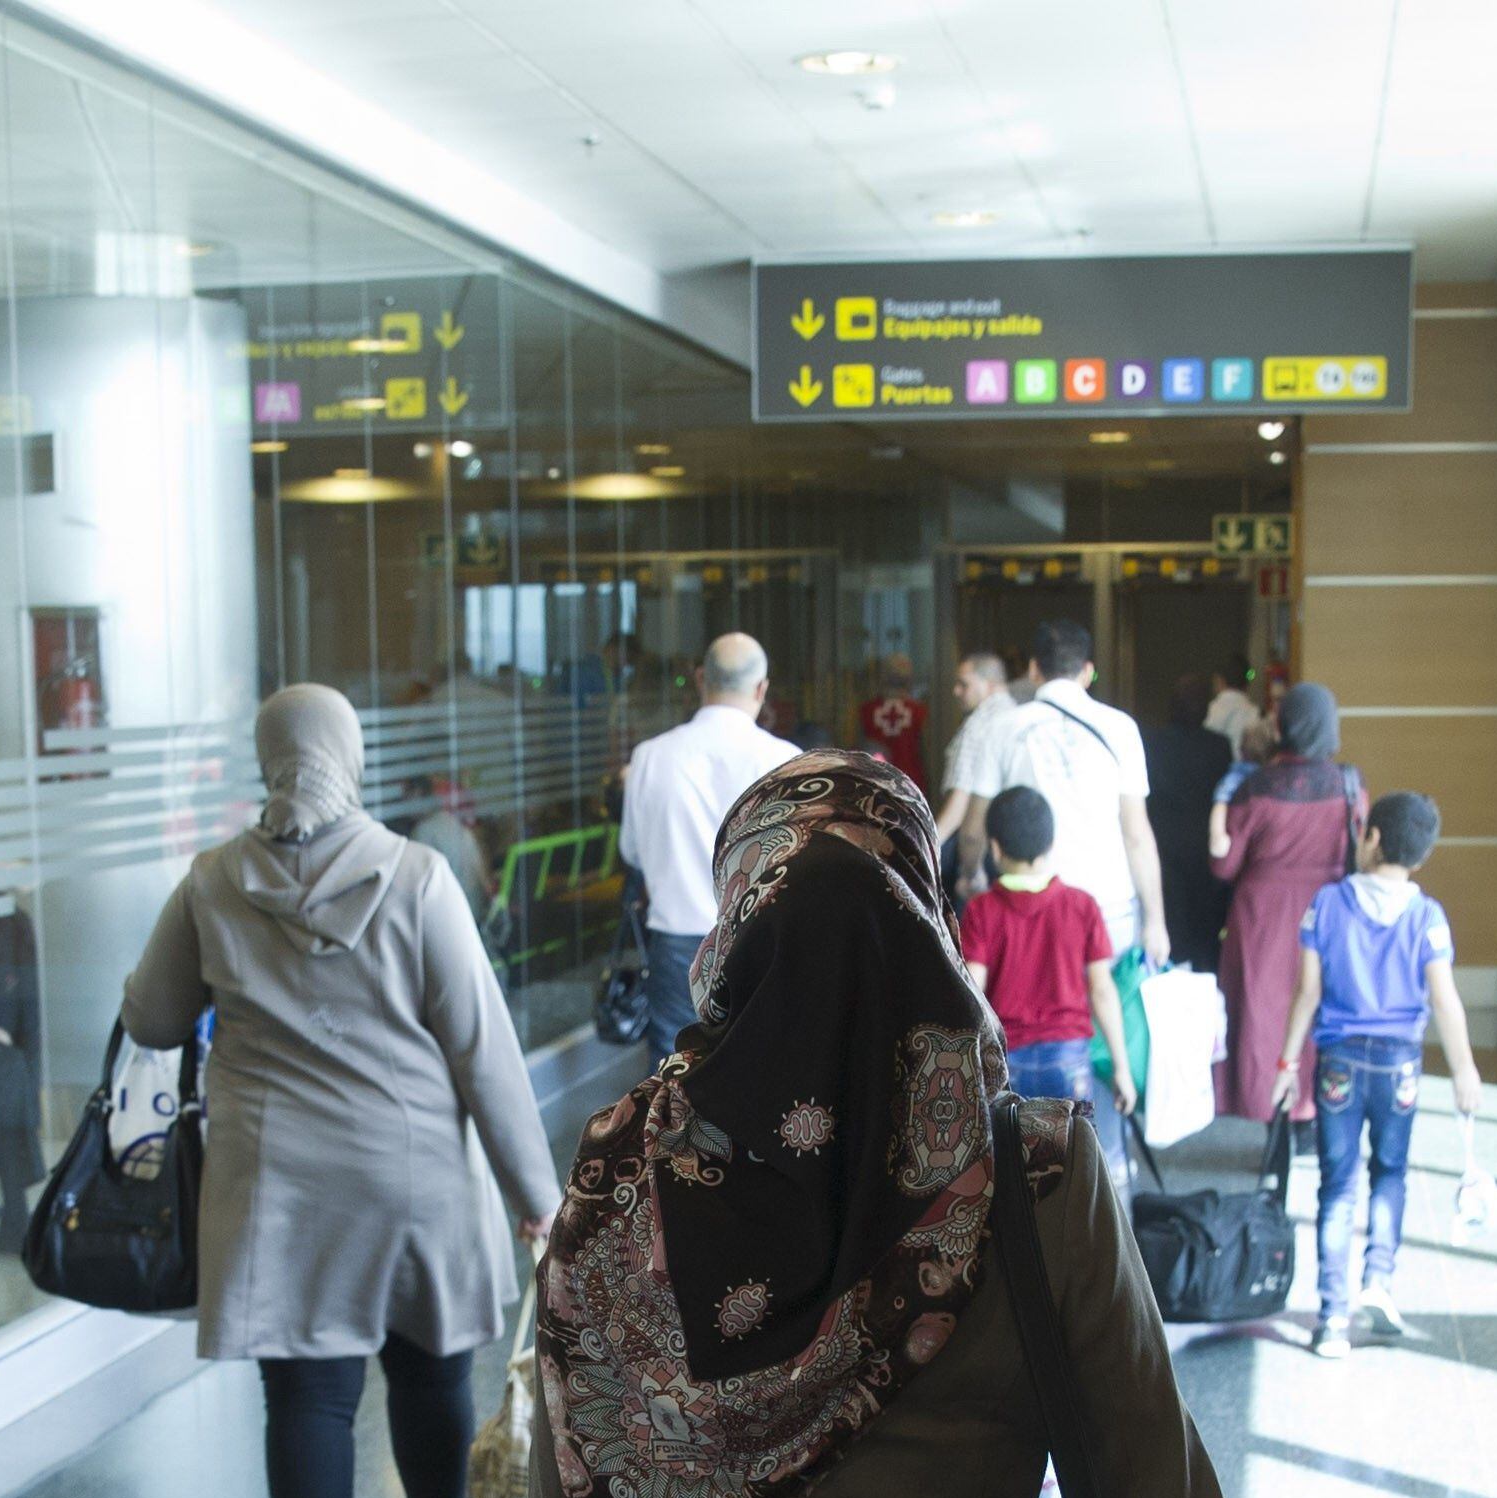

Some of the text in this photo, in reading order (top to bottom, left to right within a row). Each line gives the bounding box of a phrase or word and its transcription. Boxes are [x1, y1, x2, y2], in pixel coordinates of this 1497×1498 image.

[884, 313, 1043, 341] Equipajes y salida
[975, 366, 998, 397] A
[1024, 365, 1047, 397] B
[1072, 364, 1097, 396] C
[1121, 364, 1147, 395] D
[1172, 363, 1193, 395] E
[1222, 363, 1243, 394] F
[881, 384, 953, 405] Puertas
